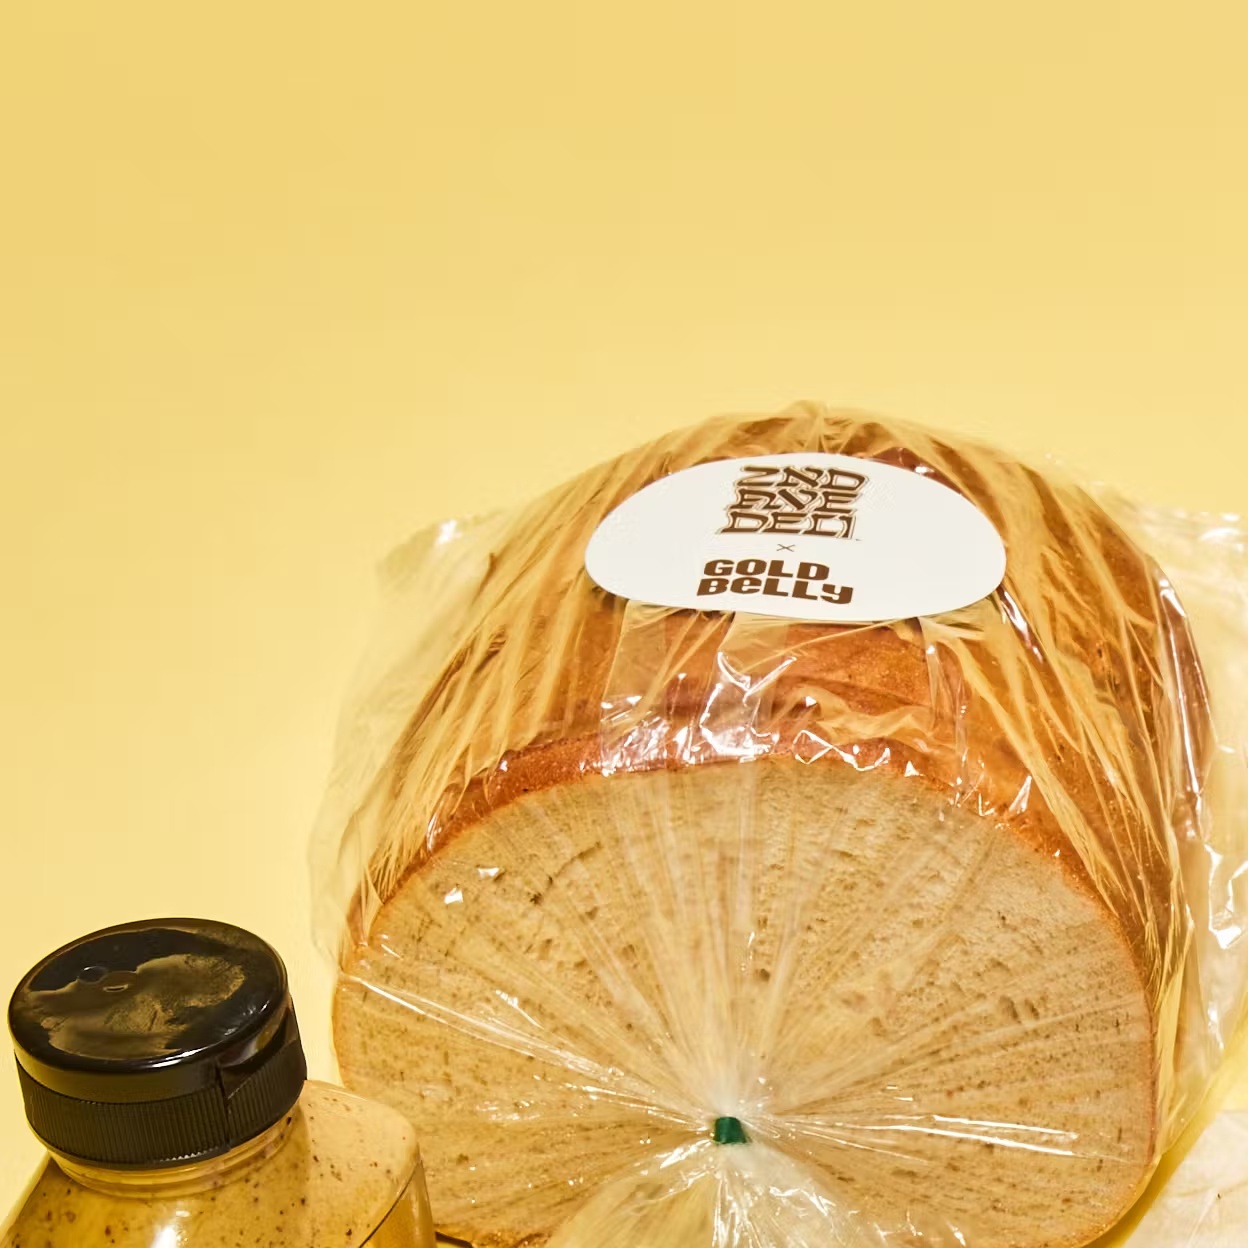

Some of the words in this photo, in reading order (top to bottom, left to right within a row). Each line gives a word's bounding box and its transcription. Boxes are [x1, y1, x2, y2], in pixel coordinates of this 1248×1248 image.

[735, 466, 869, 491] 2ND
[725, 488, 863, 514] AVE
[715, 511, 856, 539] DELI
[703, 558, 830, 581] GOLD
